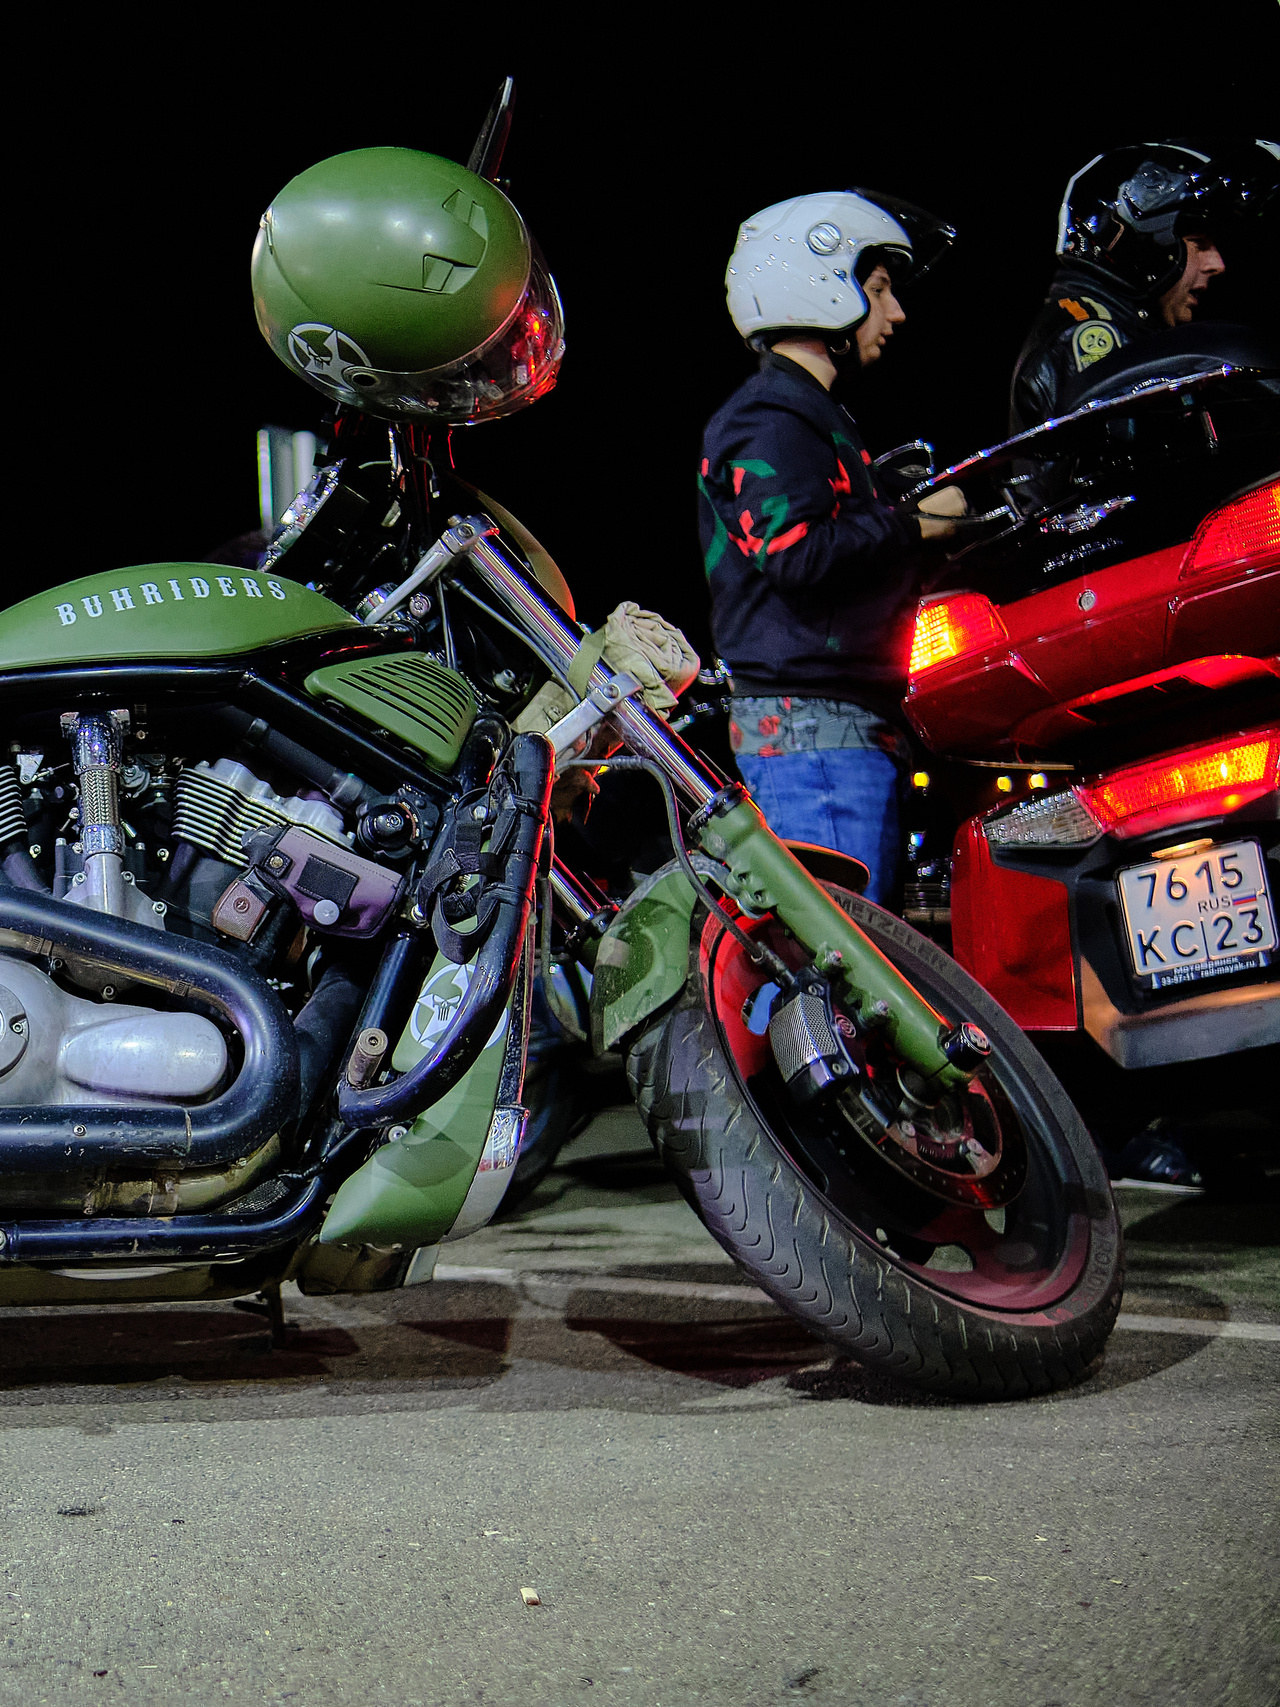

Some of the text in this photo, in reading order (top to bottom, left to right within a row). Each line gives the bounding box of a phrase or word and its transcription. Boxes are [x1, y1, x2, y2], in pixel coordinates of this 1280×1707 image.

[54, 576, 286, 627] BUHRIDERS
[1137, 853, 1243, 908] 7615
[1197, 897, 1231, 914] RUS
[1137, 907, 1264, 966] KC 23
